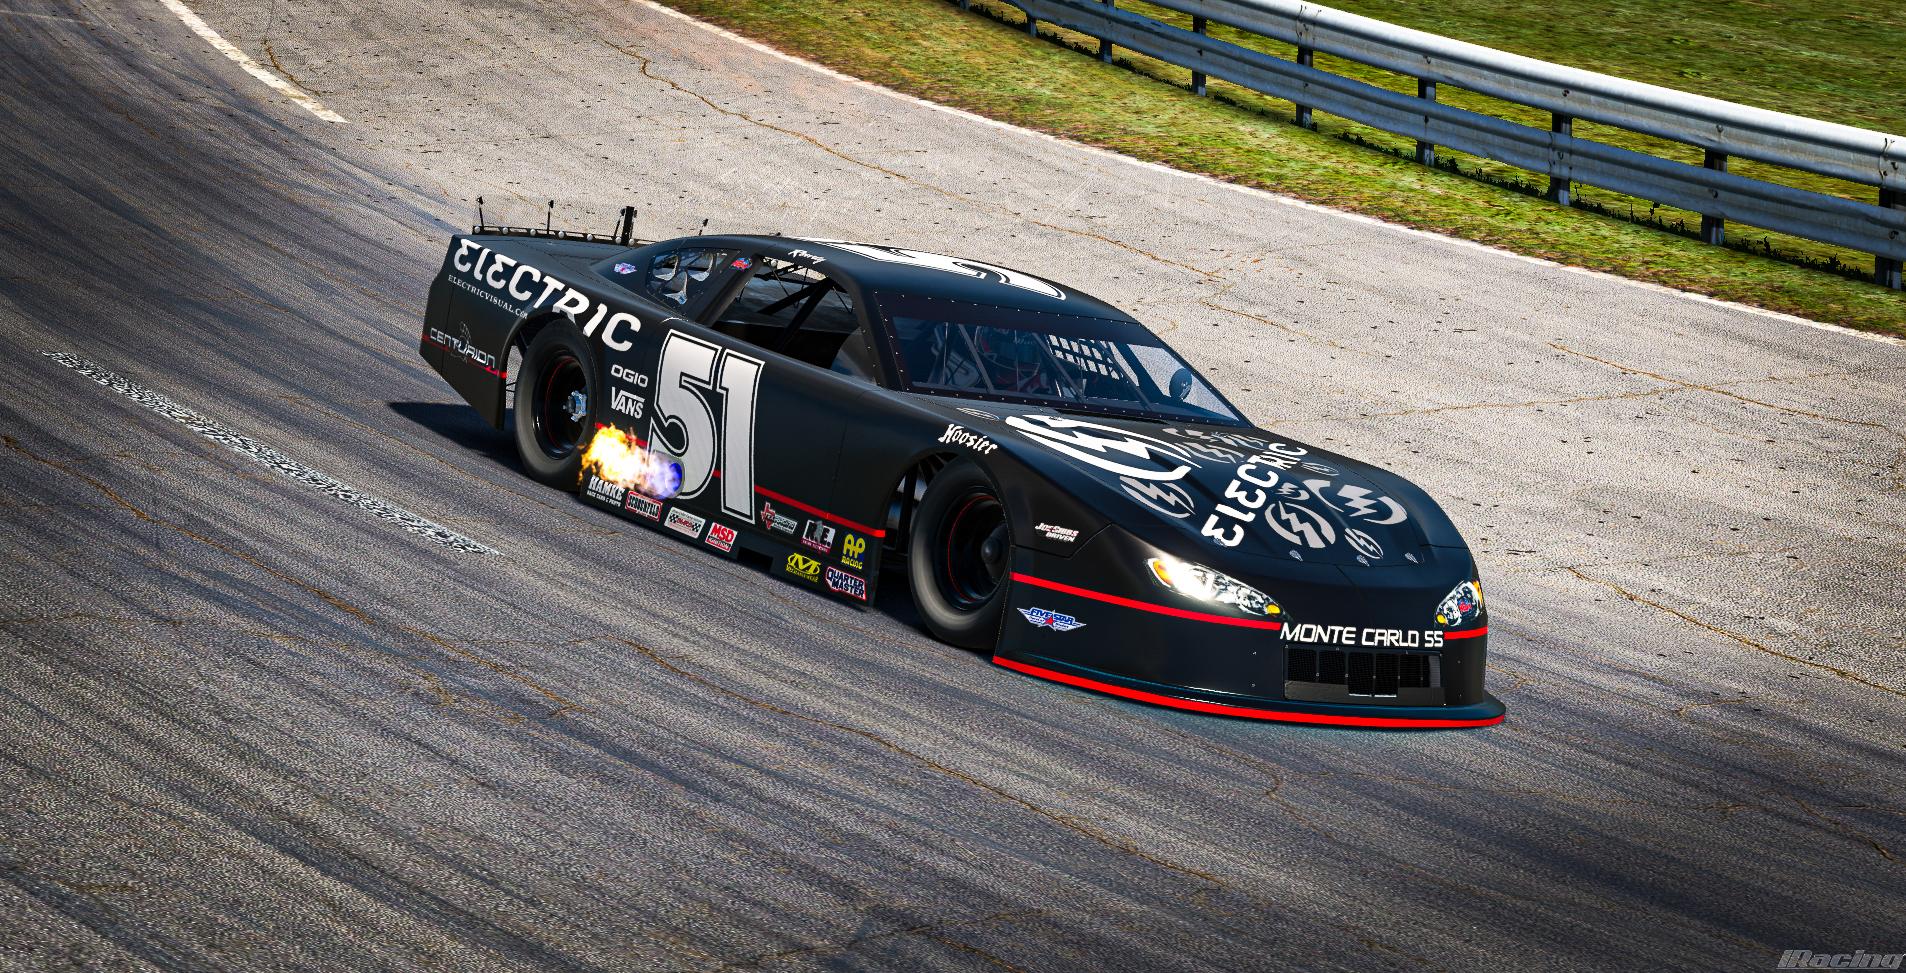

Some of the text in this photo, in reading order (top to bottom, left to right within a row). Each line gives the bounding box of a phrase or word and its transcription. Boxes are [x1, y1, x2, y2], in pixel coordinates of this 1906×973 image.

[611, 364, 649, 387] OGIO
[611, 386, 645, 419] VANS
[647, 329, 766, 524] 51
[938, 423, 999, 455] Hoosier
[710, 523, 736, 543] MSD
[1045, 531, 1076, 543] DRIVEN
[826, 567, 865, 590] QUARTER
[831, 580, 865, 598] MASTER
[1279, 622, 1444, 648] MONTE CARLO SS
